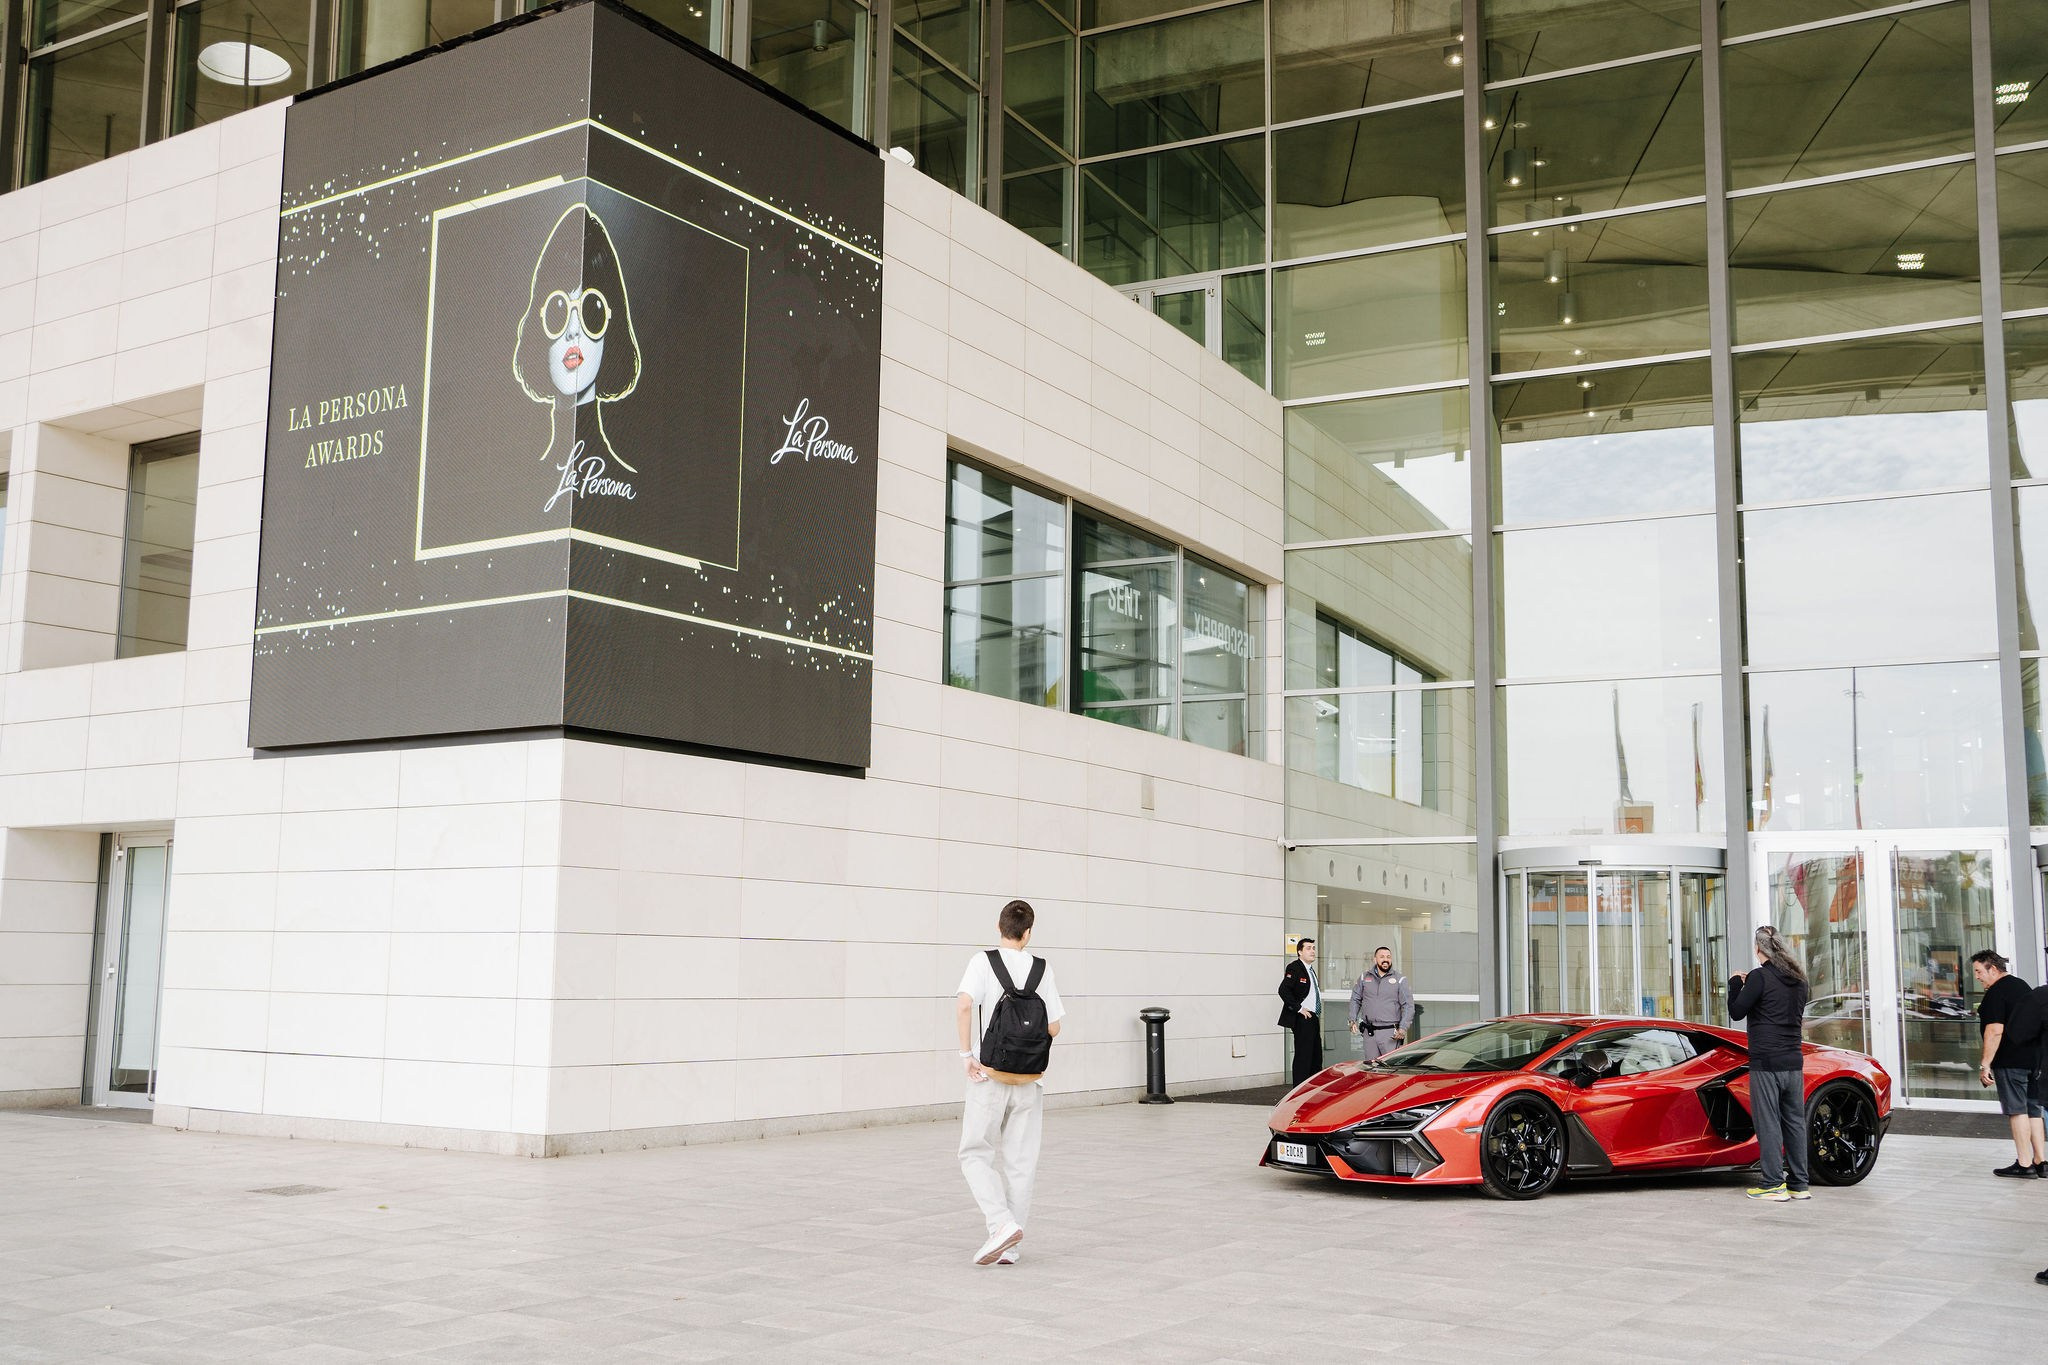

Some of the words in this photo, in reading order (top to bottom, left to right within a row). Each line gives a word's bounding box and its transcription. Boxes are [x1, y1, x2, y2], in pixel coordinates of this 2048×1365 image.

[288, 405, 312, 432] LA
[318, 383, 408, 426] PERSONA
[771, 397, 809, 465] La
[804, 415, 859, 465] Persona
[304, 429, 384, 469] AWARDS
[544, 440, 585, 513] La
[579, 456, 637, 500] Persona
